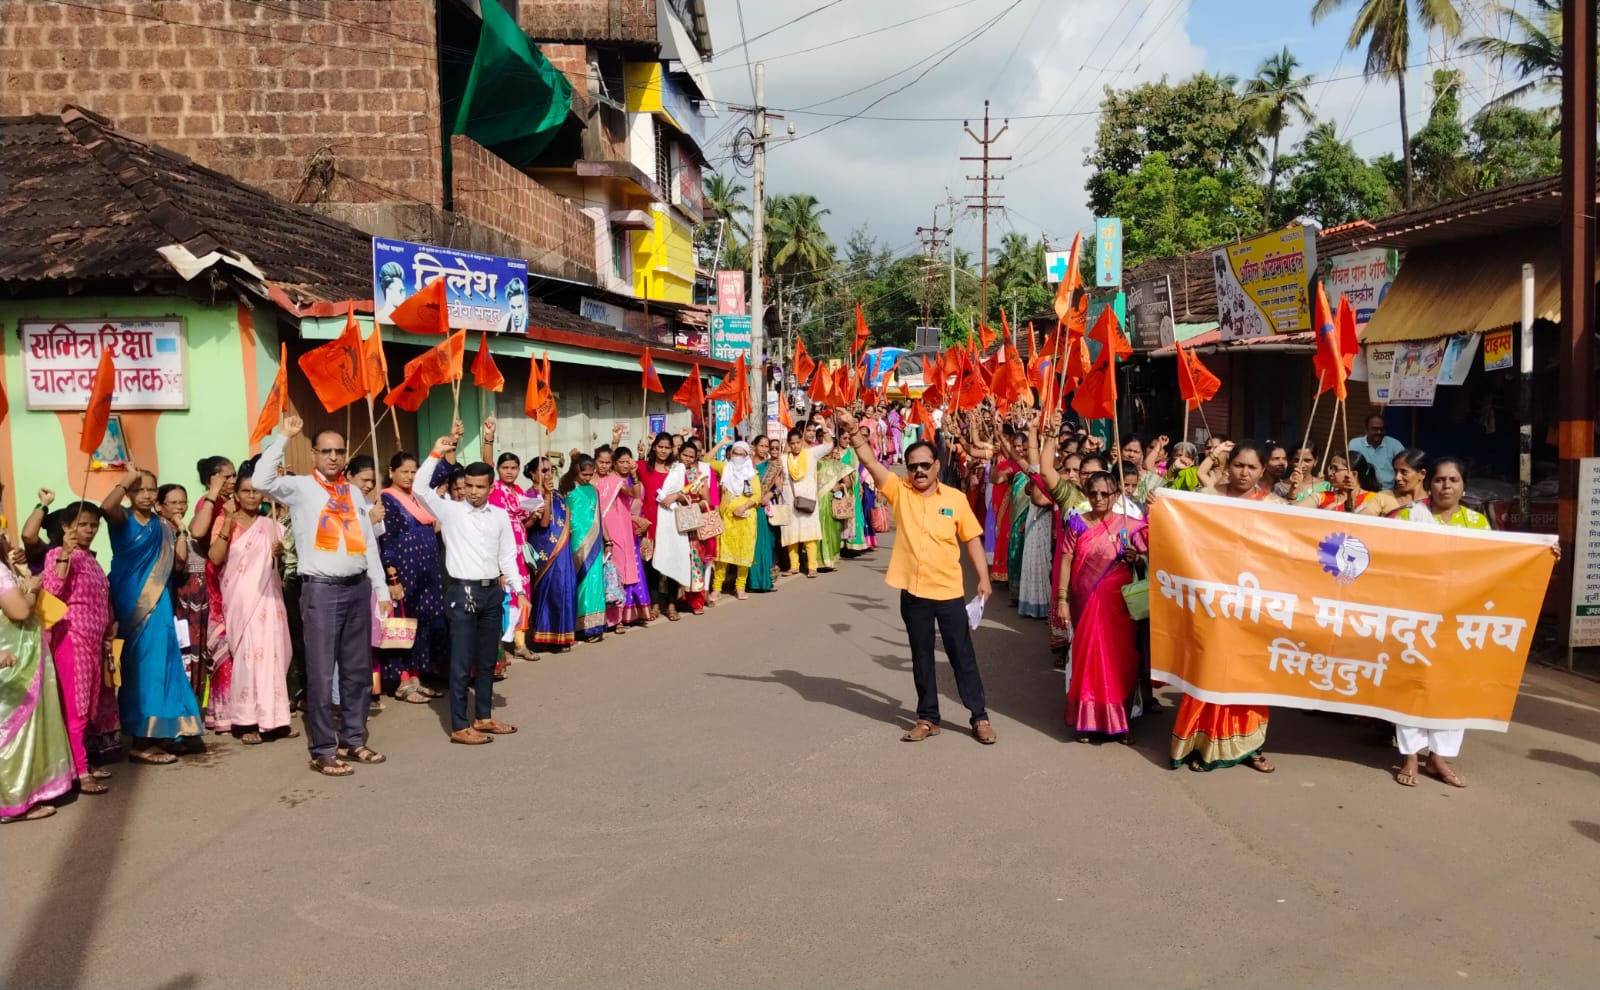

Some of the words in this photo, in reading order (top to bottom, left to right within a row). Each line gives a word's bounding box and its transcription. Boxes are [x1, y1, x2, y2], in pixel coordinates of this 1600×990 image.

[1369, 256, 1386, 280] शॉप
[98, 324, 152, 360] रिक्षा
[1156, 570, 1298, 629] भारतीय
[1312, 597, 1443, 667] मजदूर
[1456, 600, 1527, 652] संघ
[1267, 637, 1389, 695] सिंधुदुर्ग
